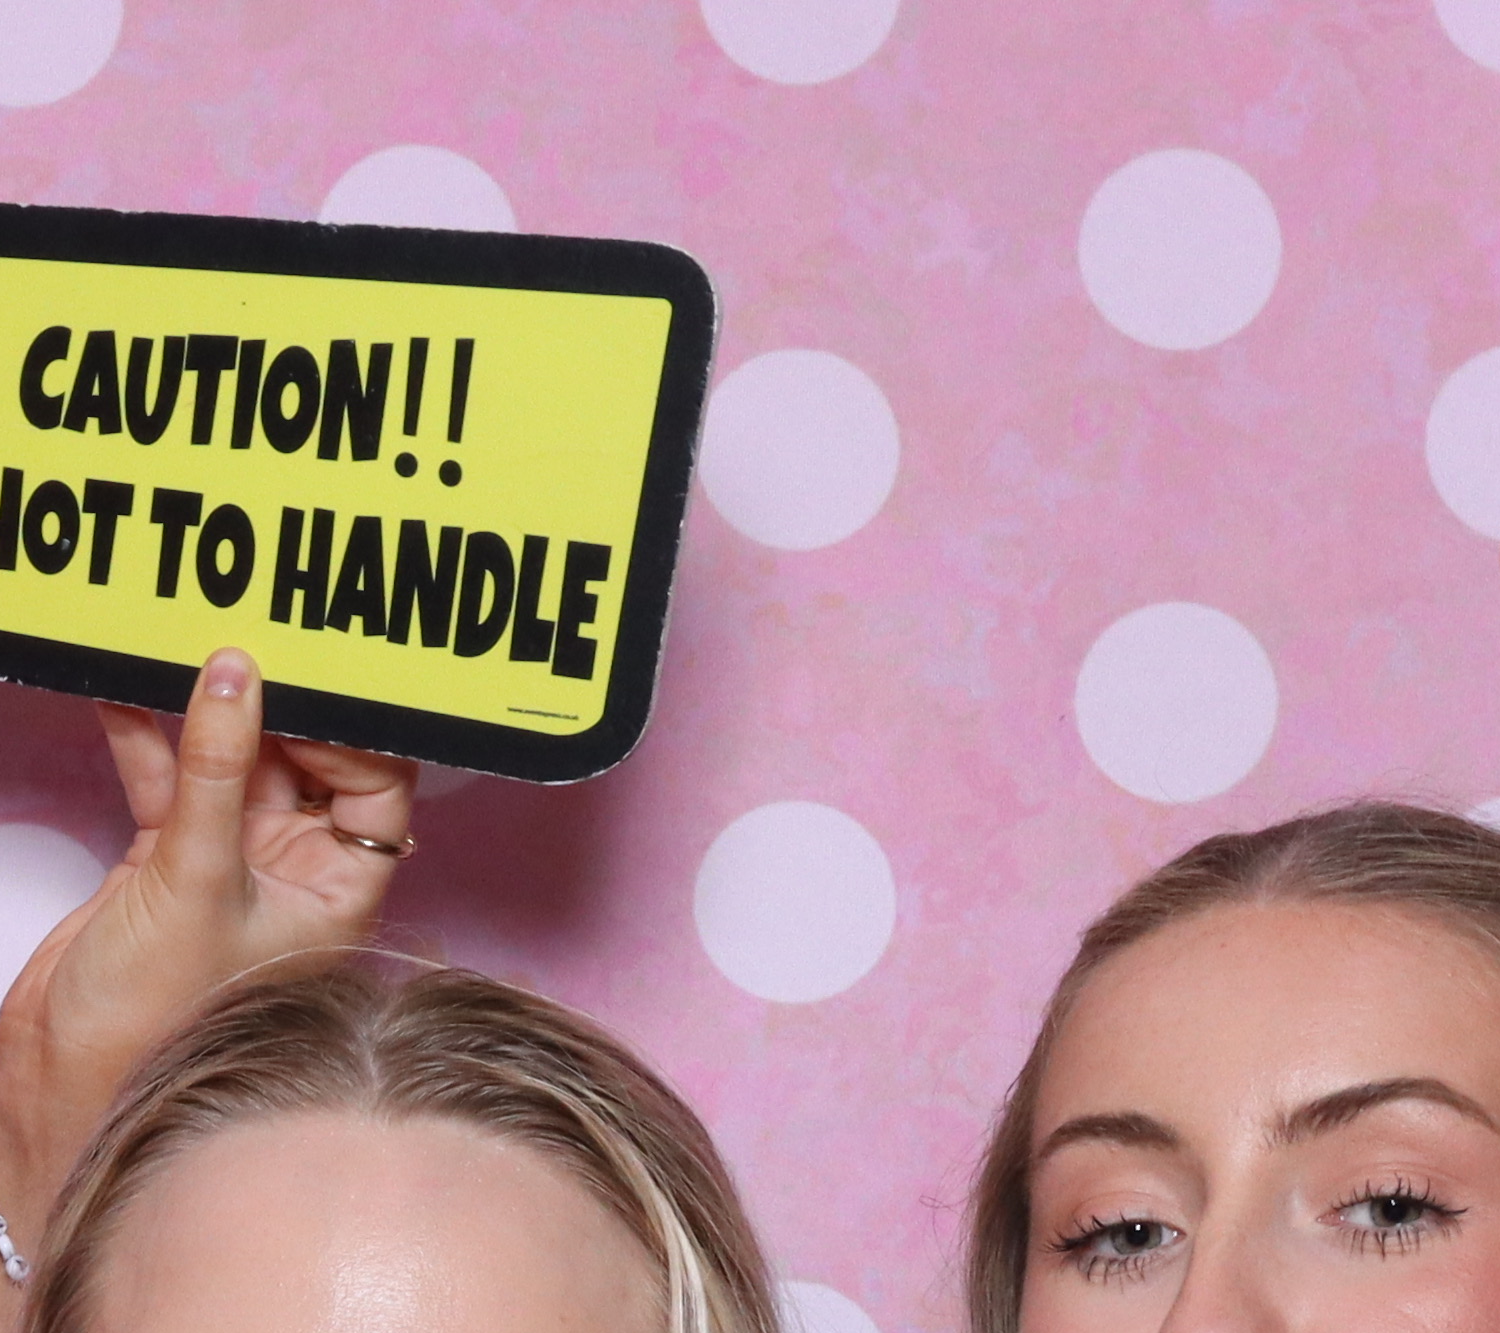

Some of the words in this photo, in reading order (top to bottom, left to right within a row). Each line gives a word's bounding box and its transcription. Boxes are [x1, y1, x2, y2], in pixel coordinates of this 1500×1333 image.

[20, 326, 475, 487] CAUTION!!
[150, 488, 256, 609] TO
[270, 507, 612, 681] HANDLE
